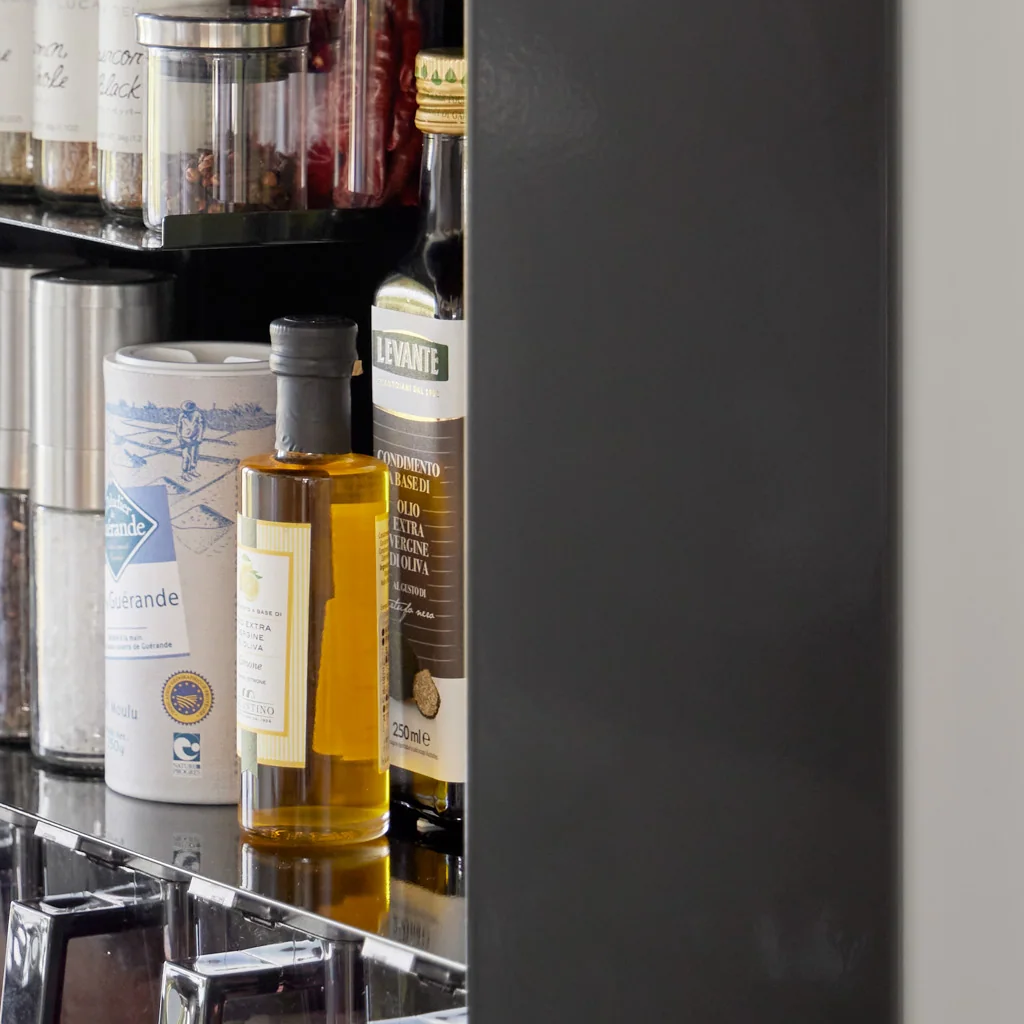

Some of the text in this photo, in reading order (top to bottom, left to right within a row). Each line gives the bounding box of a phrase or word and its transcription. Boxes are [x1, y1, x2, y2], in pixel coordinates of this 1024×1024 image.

[376, 335, 440, 376] LEVANTE
[377, 449, 441, 478] CONDIMENTO
[394, 471, 419, 492] BASE
[419, 477, 431, 494] DI
[397, 499, 421, 518] OLIO
[393, 516, 425, 539] EXTRA
[389, 533, 430, 558] VERGINE
[389, 551, 430, 576] DI OLIVA
[393, 580, 427, 599] AL GUSTO DI
[256, 608, 273, 617] BASE
[245, 620, 272, 632] EXTRA
[133, 643, 141, 651] de
[141, 641, 173, 651] Guérande
